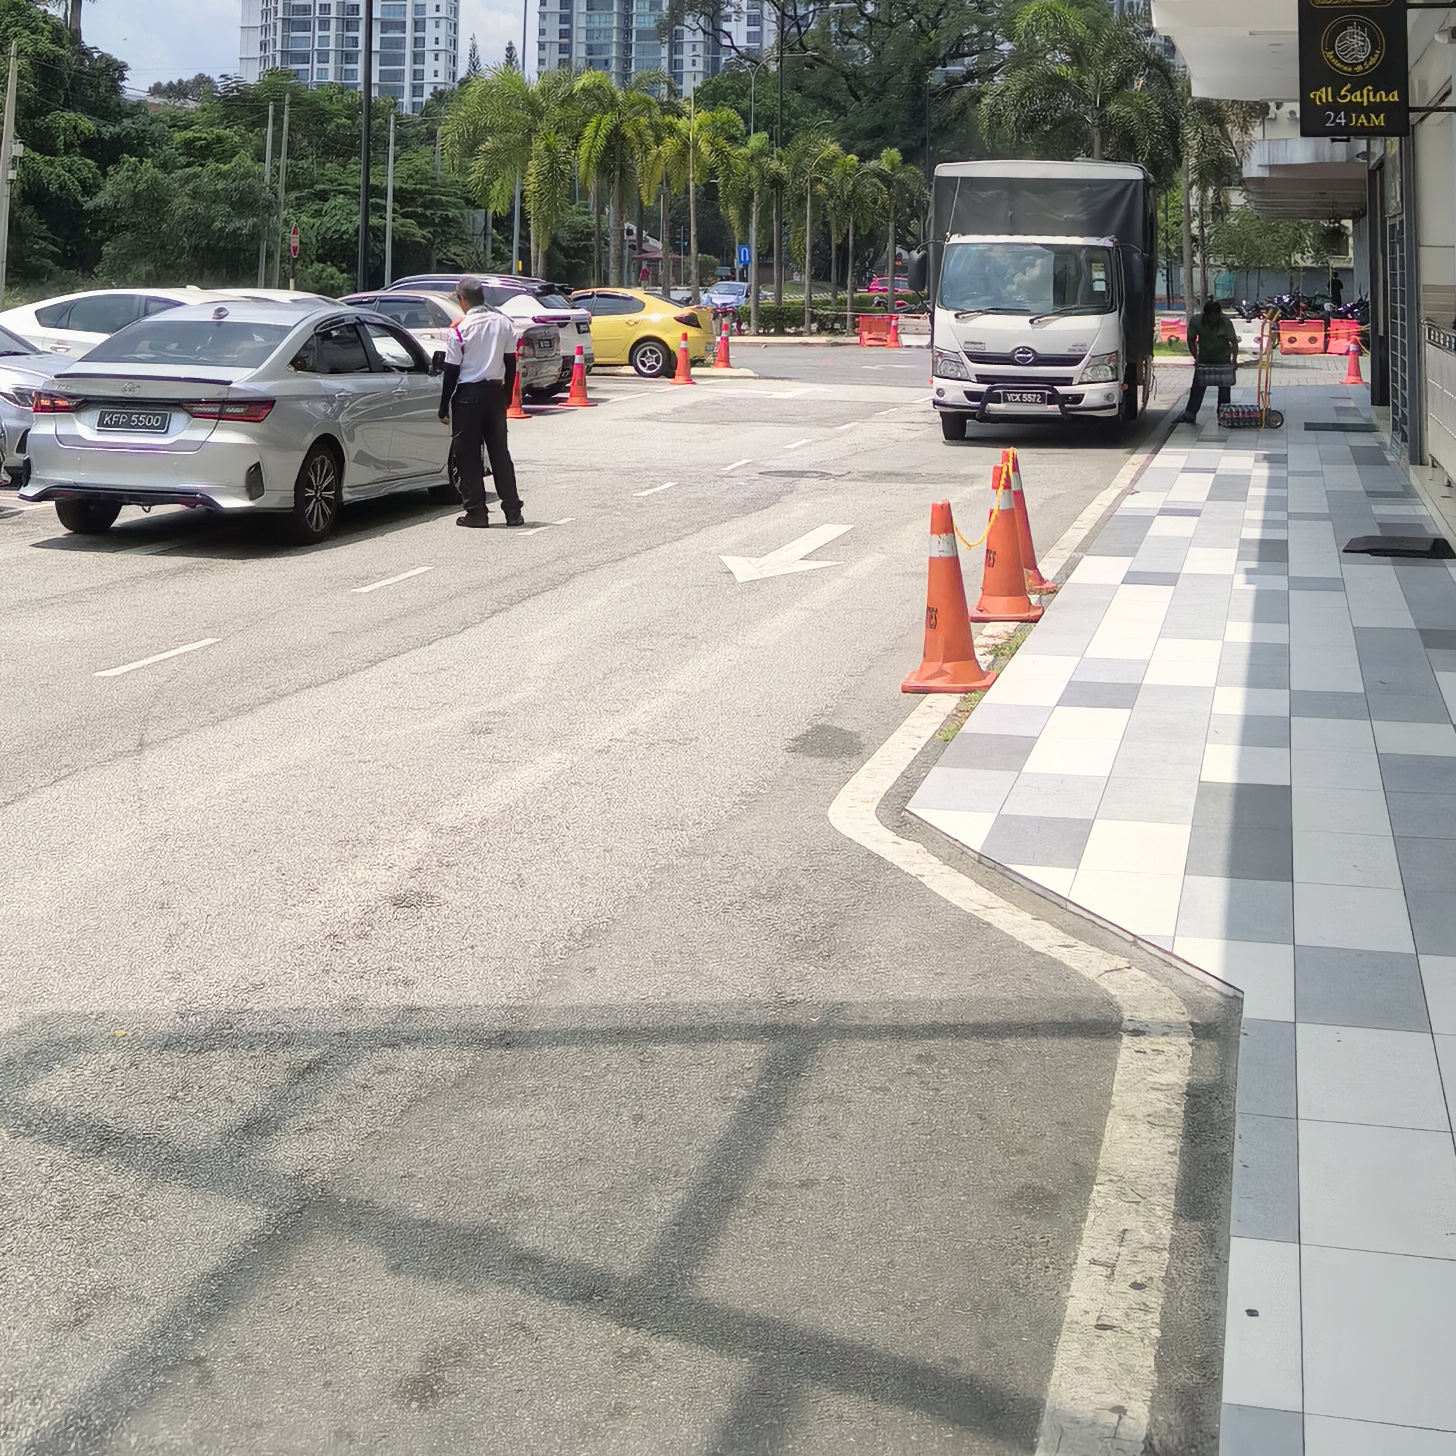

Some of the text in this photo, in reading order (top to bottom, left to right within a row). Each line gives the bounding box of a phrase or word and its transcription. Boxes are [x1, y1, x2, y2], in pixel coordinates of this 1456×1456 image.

[1309, 82, 1400, 107] Al Safina
[1324, 111, 1386, 127] 24 JAM
[103, 413, 162, 427] KFP 5500
